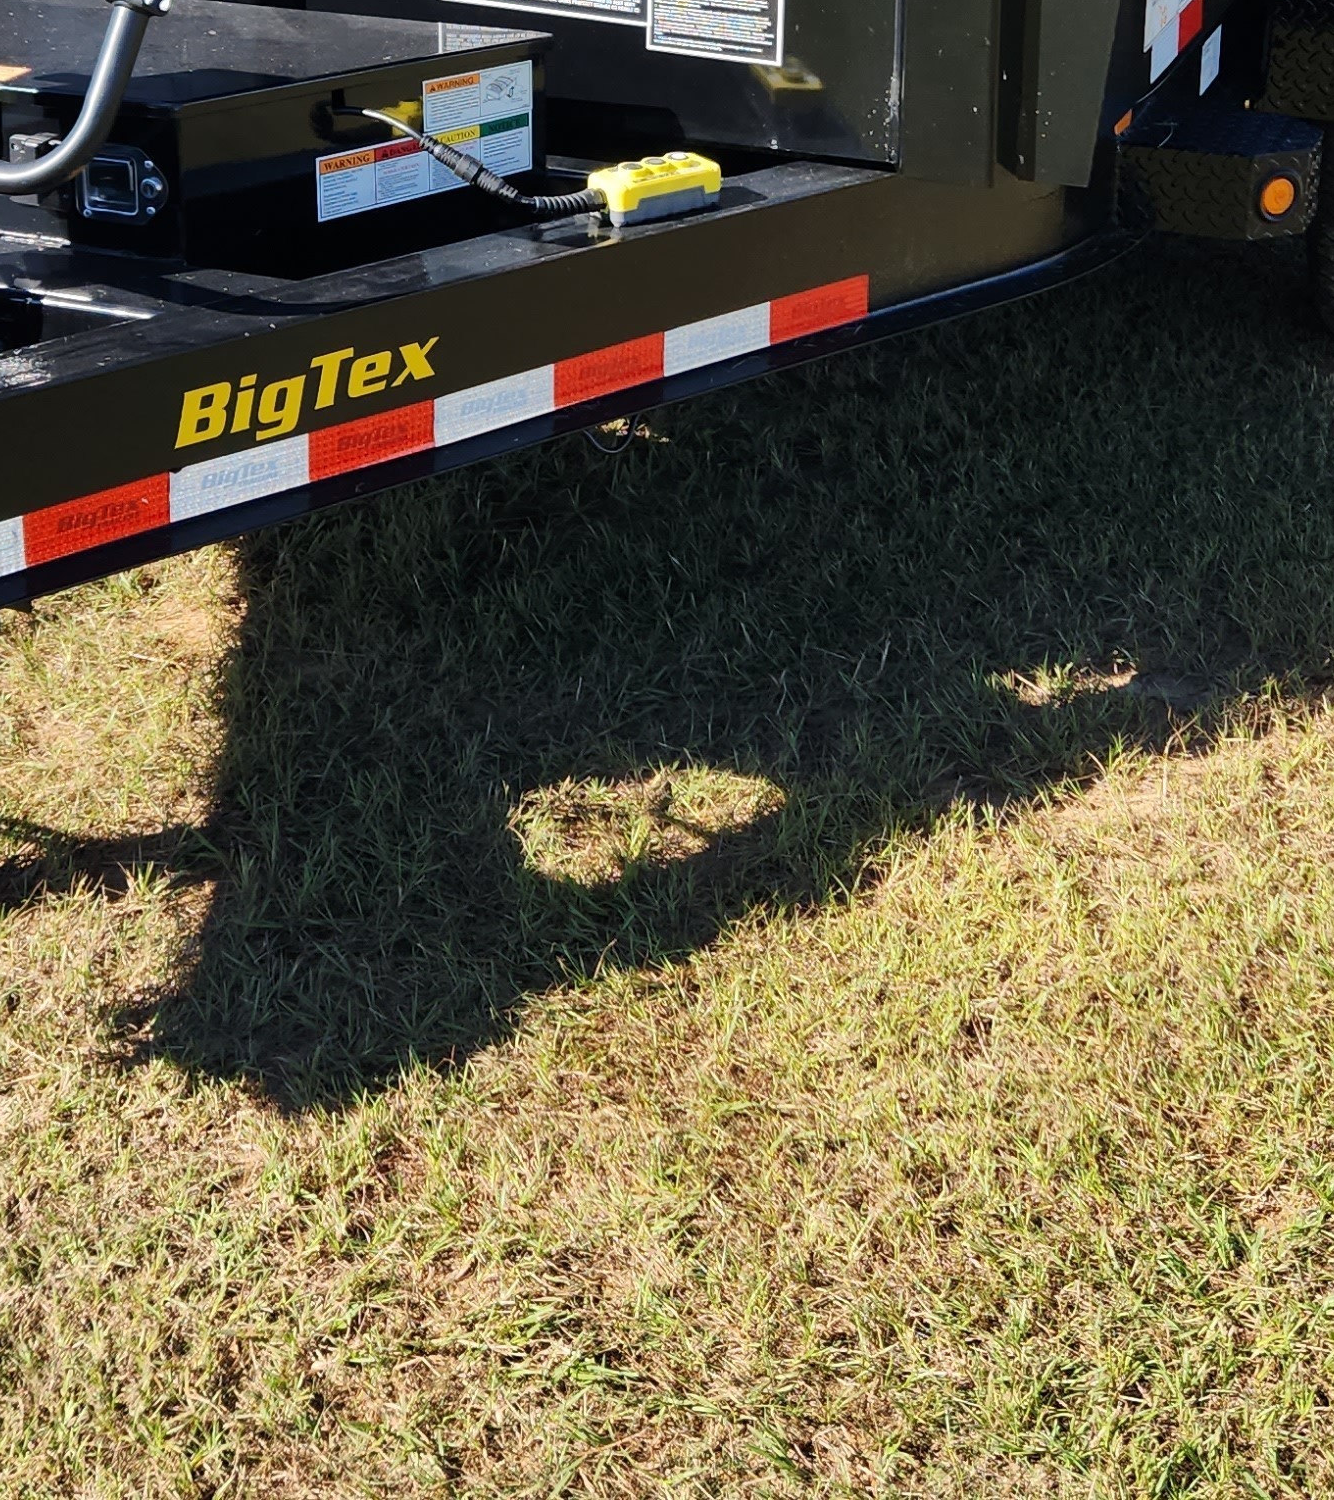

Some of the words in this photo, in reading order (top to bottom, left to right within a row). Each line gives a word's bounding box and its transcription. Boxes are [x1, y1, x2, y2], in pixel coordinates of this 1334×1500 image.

[437, 76, 474, 91] WARNING
[389, 142, 422, 156] DANGE
[324, 153, 371, 171] WARNING
[174, 336, 440, 450] BigTex
[202, 460, 280, 490] BigTex
